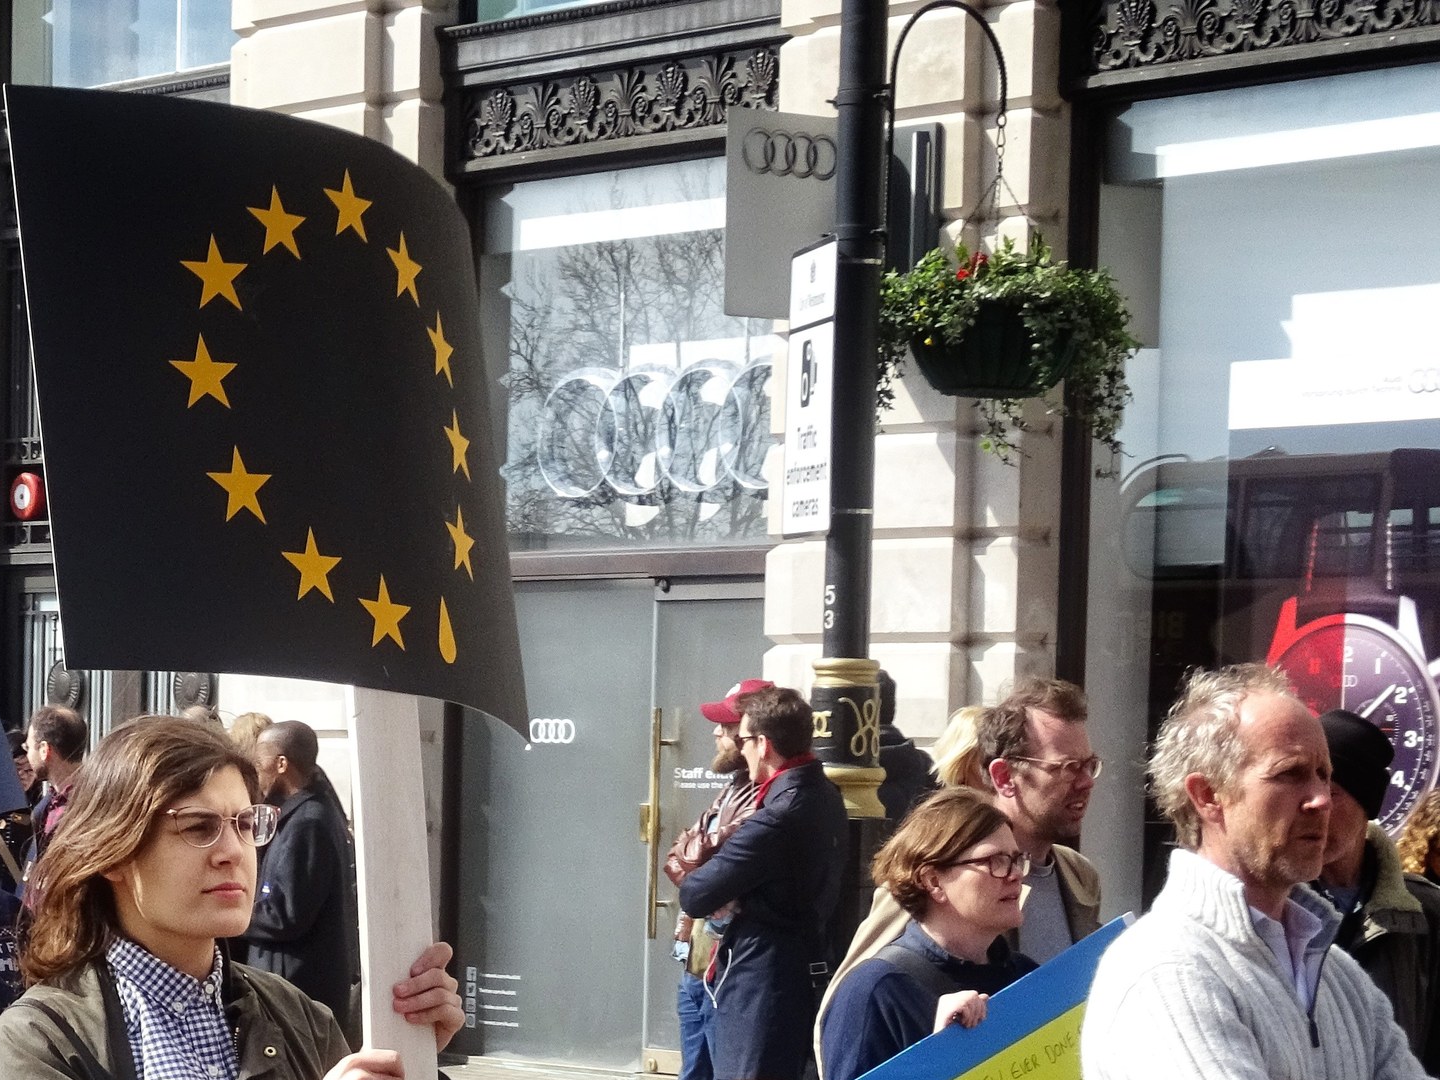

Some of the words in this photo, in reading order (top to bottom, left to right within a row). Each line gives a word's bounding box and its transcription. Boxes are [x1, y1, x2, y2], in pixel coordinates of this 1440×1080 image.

[797, 424, 817, 450] Traffic
[1394, 686, 1408, 704] 2
[1404, 729, 1418, 748] 3
[673, 767, 703, 779] Staff
[1390, 770, 1405, 788] 4
[1011, 1055, 1042, 1080] EVER
[1044, 1031, 1075, 1064] DONE
